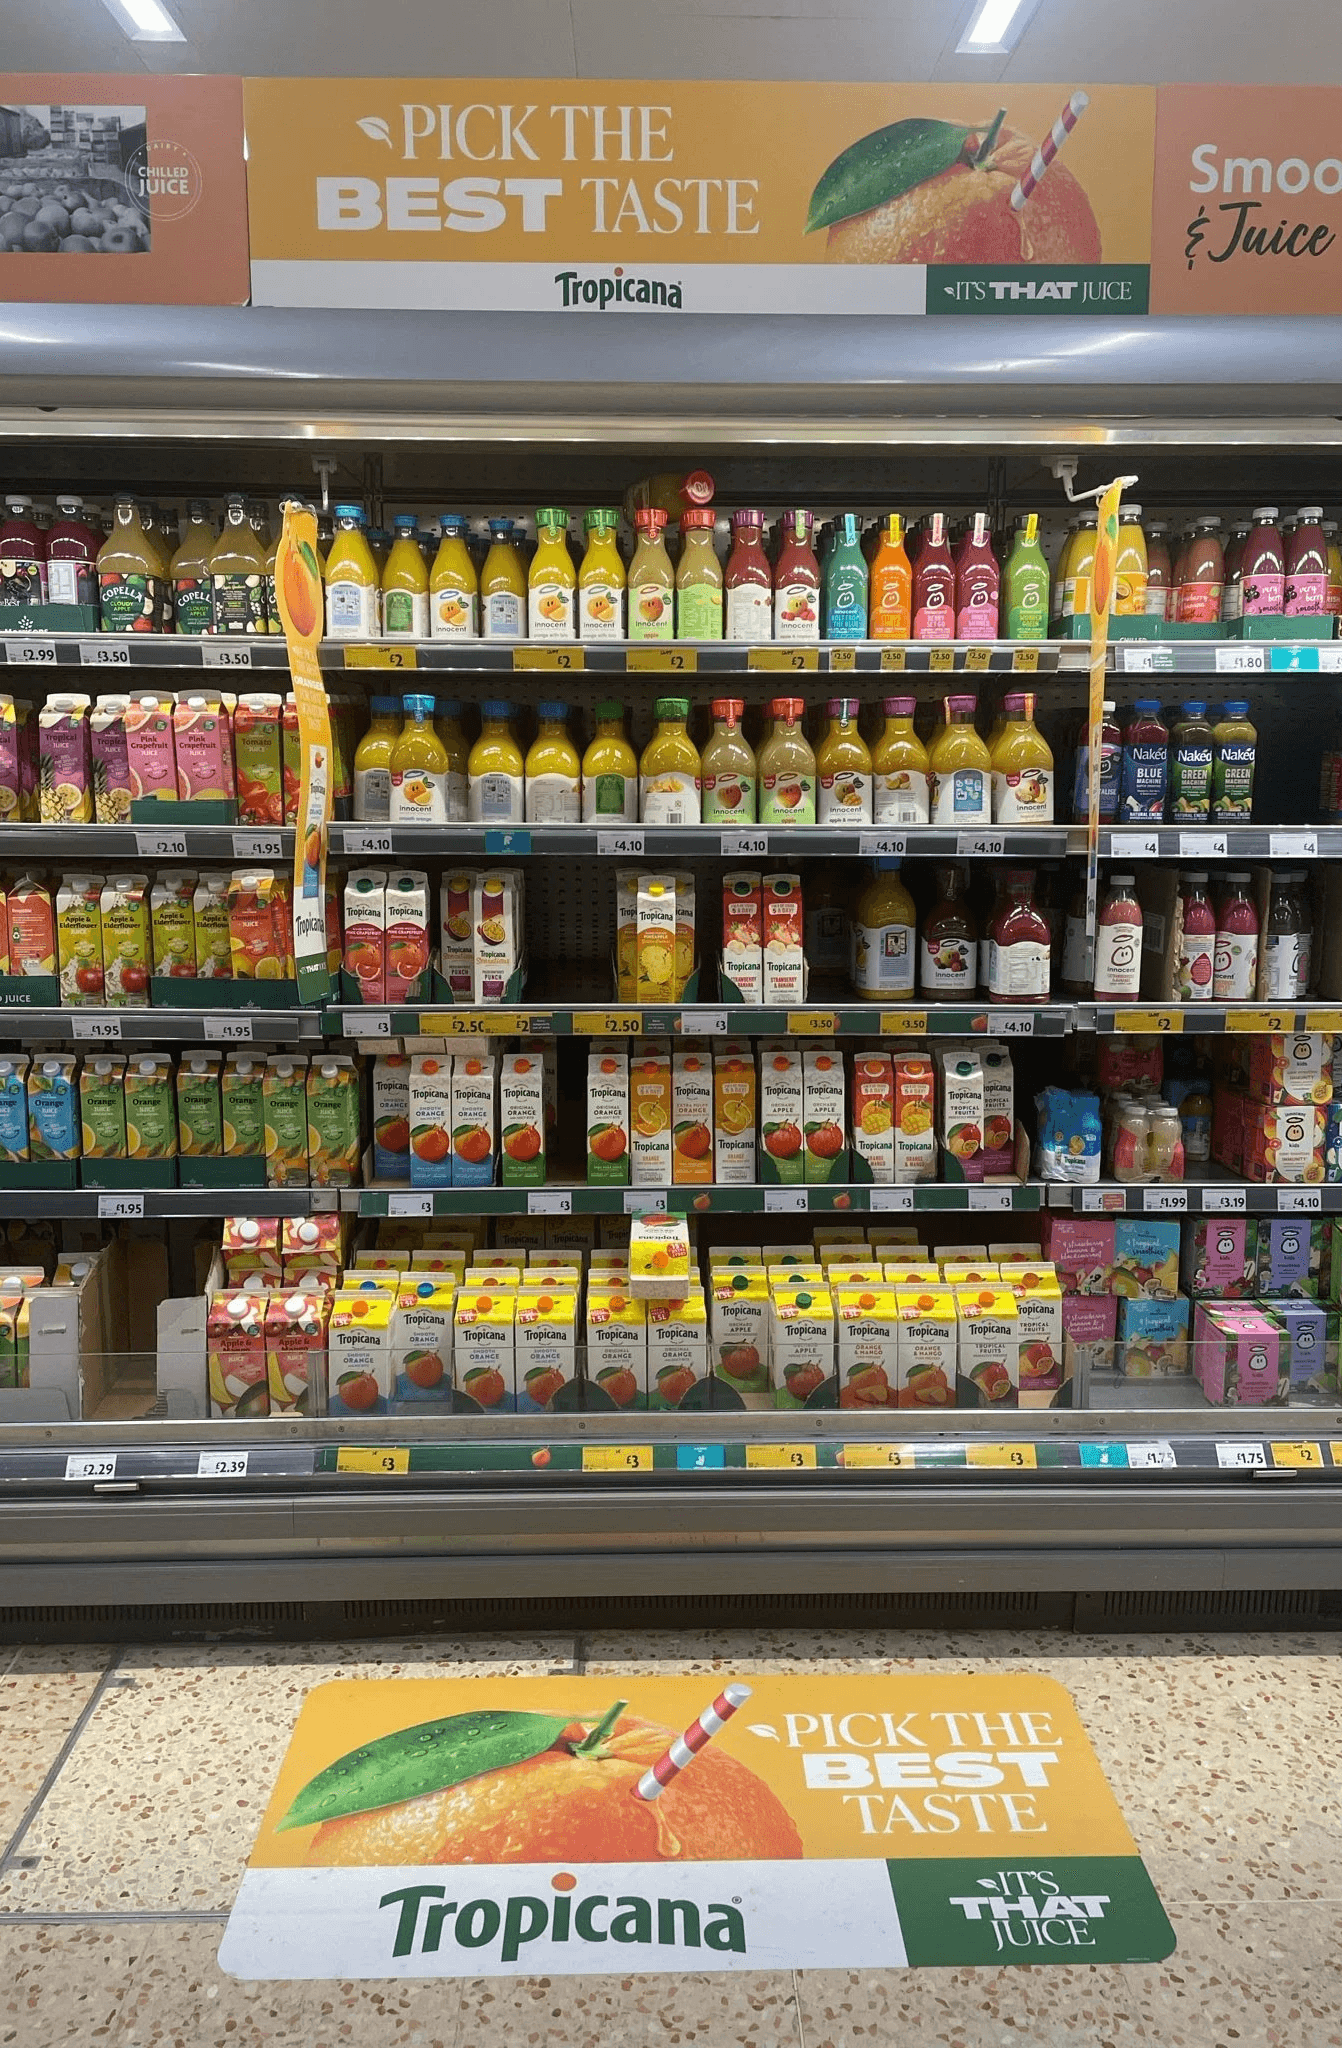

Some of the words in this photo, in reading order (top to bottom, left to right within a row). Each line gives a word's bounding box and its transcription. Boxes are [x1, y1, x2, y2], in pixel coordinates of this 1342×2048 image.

[401, 104, 539, 162] PICK
[549, 105, 674, 163] THE
[146, 143, 179, 151] DAIRY
[138, 166, 189, 178] CHILLED
[138, 179, 189, 197] JUICE
[316, 176, 562, 232] BEST
[579, 178, 761, 235] TASTE
[1207, 201, 1336, 263] Juice
[555, 267, 683, 310] Tropicana
[955, 281, 986, 301] IT'S
[988, 280, 1078, 299] THAT
[1082, 281, 1132, 304] JUICE
[102, 585, 143, 602] COPELLA
[1299, 585, 1316, 595] very
[1306, 594, 1323, 603] berry
[535, 621, 566, 629] innocent
[23, 649, 54, 662] £2.99
[98, 650, 128, 663] £3.50
[219, 652, 249, 665] £3.50
[390, 654, 404, 667] £2
[557, 655, 572, 668] £2
[671, 655, 684, 669] £2
[791, 655, 805, 669] £2
[1235, 657, 1262, 668] £1.80
[46, 733, 77, 743] Tropical
[242, 738, 272, 746] Tomato
[130, 742, 168, 750] Grapefruit
[179, 741, 217, 750] Grapefruit
[1137, 768, 1162, 778] BLUE
[1181, 769, 1208, 779] GREEN
[1224, 768, 1251, 778] GREEN
[157, 842, 185, 853] £2.10
[253, 843, 280, 855] £1.95
[362, 839, 390, 850] £4.10
[615, 840, 642, 852] £4.10
[738, 840, 766, 852] £4.10
[877, 841, 904, 853] £4.10
[974, 841, 1001, 853] £4.10
[1145, 842, 1157, 854] £4
[1213, 842, 1225, 854] £4
[1303, 842, 1315, 854] £4
[346, 907, 382, 918] Tropicana
[388, 906, 423, 918] Tropicana
[639, 911, 673, 922] Tropicana
[295, 912, 324, 935] Tropicana
[726, 961, 761, 972] Tropicana
[767, 961, 801, 972] Tropicana
[5, 994, 31, 1003] JUICE
[378, 1022, 389, 1033] £3
[605, 1019, 639, 1032] £2.50
[716, 1020, 726, 1031] £3
[809, 1019, 832, 1029] £3.50
[902, 1019, 925, 1029] £3.50
[1004, 1021, 1032, 1033] £4.10
[1158, 1018, 1170, 1030] £2
[1268, 1018, 1281, 1030] £2
[91, 1025, 119, 1036] £1.95
[223, 1026, 250, 1037] £1.95
[411, 1088, 449, 1100] Tropicana
[454, 1089, 491, 1100] Tropicana
[503, 1088, 540, 1099] Tropicana
[590, 1087, 626, 1098] Tropicana
[674, 1086, 710, 1097] Tropicana
[764, 1086, 800, 1096] Tropicana
[807, 1085, 843, 1096] Tropicana
[948, 1091, 982, 1101] Tropicana
[35, 1099, 64, 1109] Orange
[87, 1098, 116, 1107] Orange
[633, 1141, 669, 1152] Tropicana
[898, 1140, 932, 1151] Tropicana
[421, 1202, 431, 1213] £3
[560, 1200, 570, 1211] £3
[655, 1199, 666, 1210] £3
[796, 1198, 807, 1209] £3
[902, 1197, 912, 1208] £3
[1001, 1196, 1011, 1207] £3
[1160, 1197, 1186, 1208] £1.99
[1220, 1197, 1244, 1208] £3.19
[1294, 1197, 1319, 1209] £4.10
[116, 1203, 142, 1215] £1.95
[721, 1305, 762, 1317] Tropicana
[403, 1313, 445, 1325] Tropicana
[524, 1329, 567, 1342] Tropicana
[595, 1328, 638, 1341] Tropicana
[785, 1324, 827, 1336] Tropicana
[847, 1324, 890, 1337] Tropicana
[968, 1323, 1011, 1336] Tropicana
[337, 1332, 381, 1345] Tropicana
[409, 1335, 439, 1343] ORANGE
[790, 1453, 803, 1467] £3
[887, 1452, 901, 1466] £3
[1010, 1452, 1024, 1466] £3
[1237, 1451, 1264, 1464] £1.75
[1301, 1448, 1313, 1461] £2
[382, 1457, 395, 1471] £3
[626, 1454, 639, 1468] £3
[83, 1462, 114, 1476] £2.29
[215, 1461, 246, 1474] £2.39
[784, 1713, 921, 1747] PICK
[930, 1713, 1063, 1747] THE
[802, 1751, 1059, 1789] BEST
[842, 1792, 1048, 1834] TASTE
[1000, 1868, 1059, 1896] IT'S
[949, 1895, 1111, 1920] THAT
[380, 1872, 747, 1962] Tropicana
[990, 1918, 1095, 1951] JUICE
